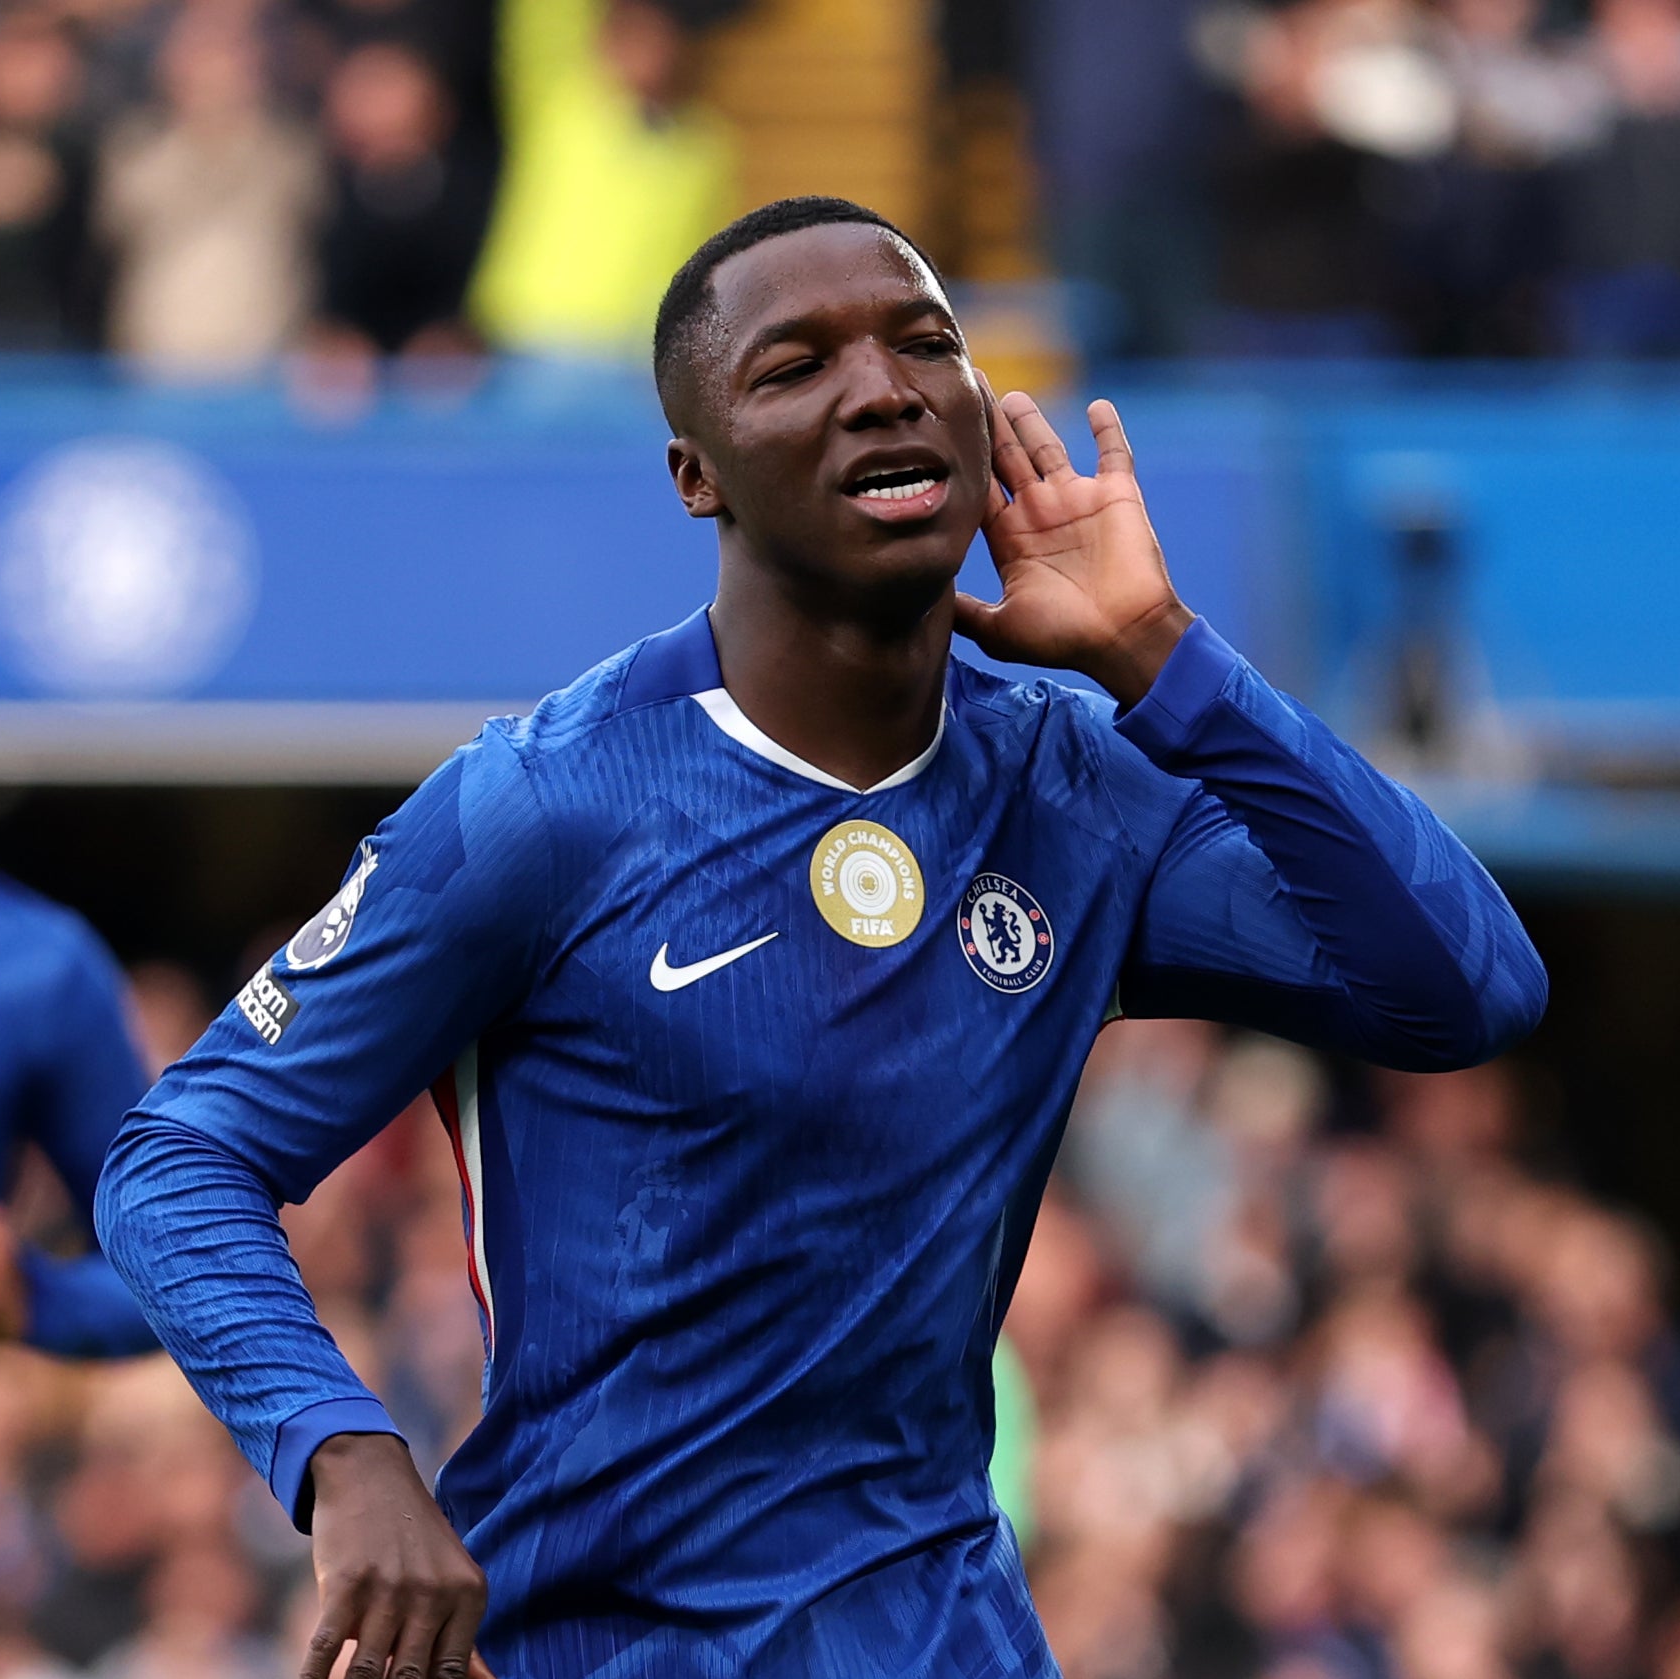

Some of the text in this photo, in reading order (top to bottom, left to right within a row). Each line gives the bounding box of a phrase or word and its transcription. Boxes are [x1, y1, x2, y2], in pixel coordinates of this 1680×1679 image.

[821, 830, 915, 901] WORLD CHAMPIONS
[966, 877, 1018, 904] CHELSEA
[849, 917, 895, 936] FIFA
[981, 959, 1044, 987] FOOTBALL CLUB
